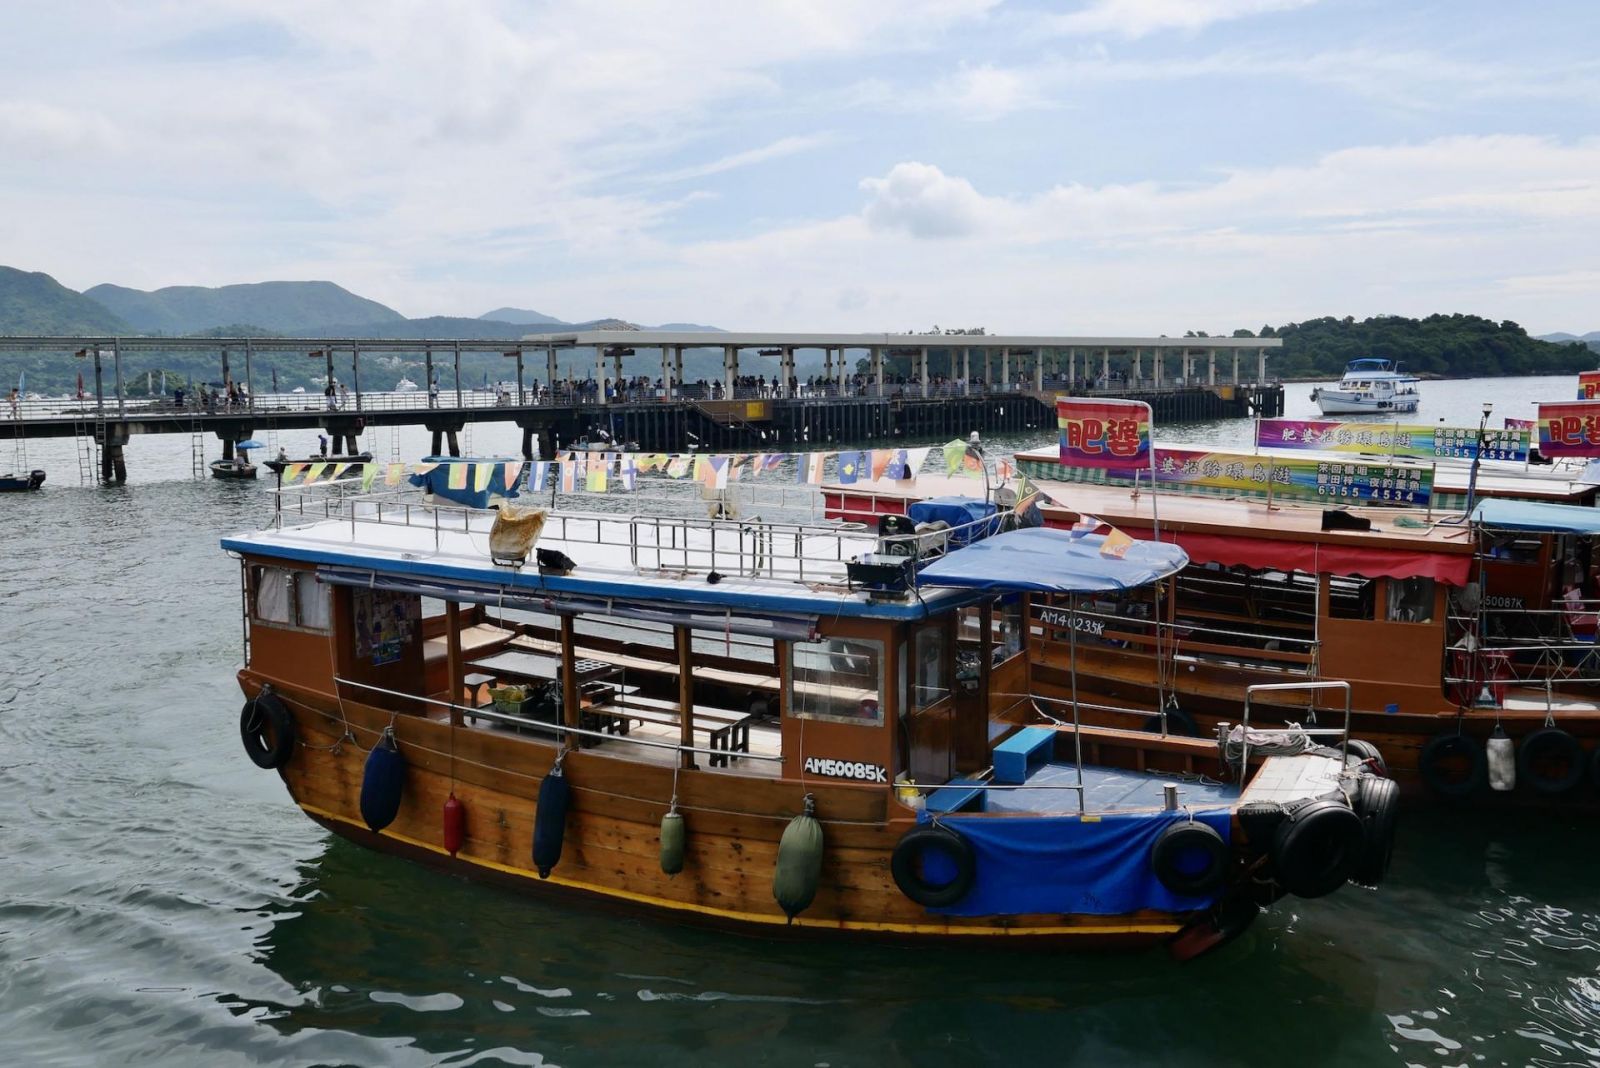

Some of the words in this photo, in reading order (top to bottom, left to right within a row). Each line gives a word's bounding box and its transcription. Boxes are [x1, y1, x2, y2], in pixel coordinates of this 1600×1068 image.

[1066, 418, 1140, 456] 肥婆
[1435, 448, 1470, 458] 6355
[1141, 456, 1292, 485] 婆船務環島遊
[1318, 485, 1360, 497] 6355
[1371, 489, 1414, 502] 4534
[804, 757, 888, 783] AM50085K
